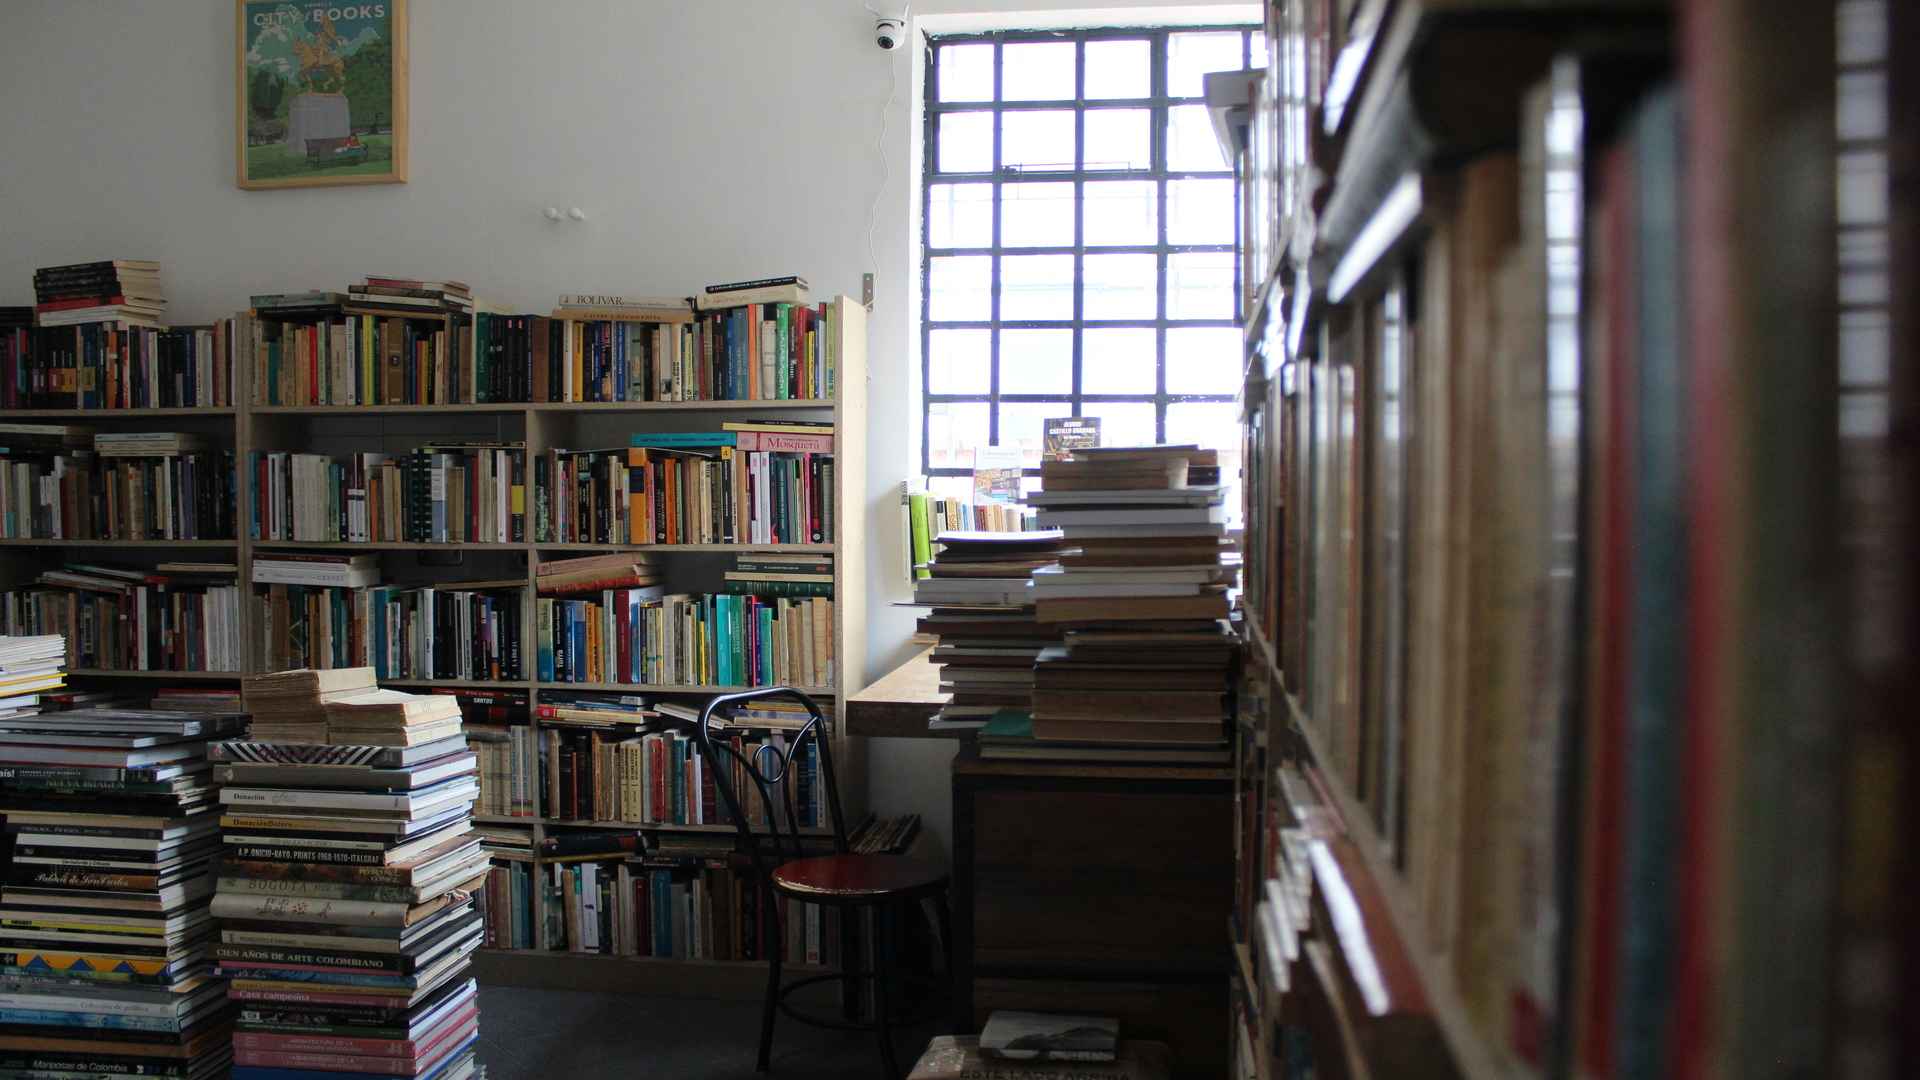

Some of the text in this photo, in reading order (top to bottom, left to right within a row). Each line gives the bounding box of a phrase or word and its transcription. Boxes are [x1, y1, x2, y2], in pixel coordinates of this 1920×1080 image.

[313, 4, 385, 23] BOOKS
[216, 948, 383, 968] CIEN AÑOS DE ARTE COLOMBIANO
[76, 1062, 88, 1070] de
[89, 1062, 129, 1073] Colombia
